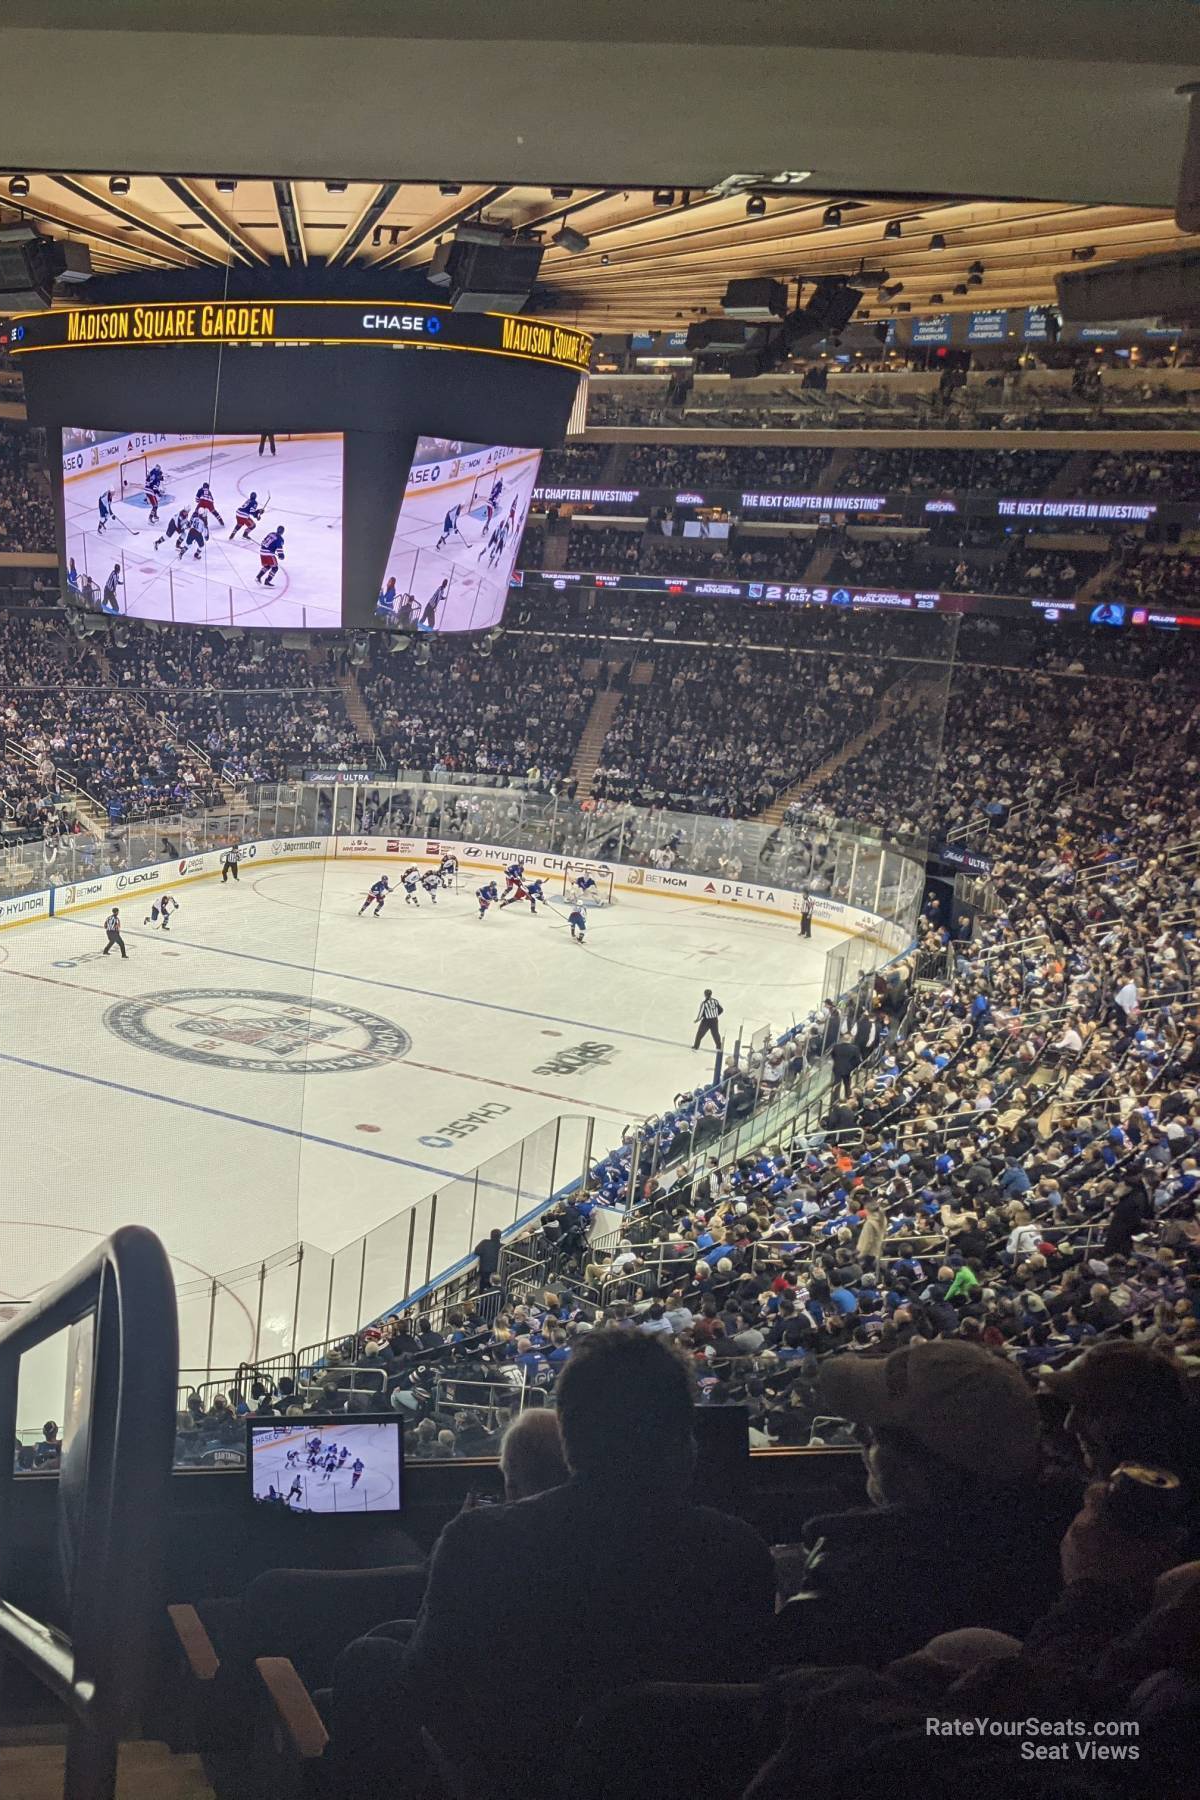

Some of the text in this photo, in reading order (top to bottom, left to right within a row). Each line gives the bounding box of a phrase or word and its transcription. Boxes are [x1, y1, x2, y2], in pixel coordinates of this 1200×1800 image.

[68, 306, 274, 341] MADISON SQUARE GARDEN
[363, 315, 423, 331] CHASE
[502, 318, 551, 356] MADISON
[545, 489, 581, 500] CHAPTER
[582, 490, 591, 500] IN
[742, 494, 758, 506] THE
[759, 495, 782, 507] NEXT
[783, 496, 822, 509] CHAPTER
[823, 497, 833, 509] IN
[998, 502, 1016, 514] THE
[1017, 503, 1042, 516] NEXT
[1043, 503, 1085, 517] CHAPTER
[1086, 505, 1098, 517] IN
[695, 586, 741, 595] RANGERS
[766, 587, 782, 599] 2
[785, 593, 811, 602] 10:57
[812, 589, 828, 602] 3
[853, 595, 911, 605] AVALANCHE
[917, 601, 934, 609] 23
[1031, 601, 1076, 610] TAKEAWAYS
[1044, 609, 1059, 620] 3
[1148, 615, 1178, 623] FOLLOW
[343, 773, 370, 781] ULTRA
[220, 847, 249, 865] CSE
[485, 849, 537, 865] HYUNDAI
[128, 871, 159, 886] LEXUS
[646, 873, 688, 888] BETMGM
[77, 884, 103, 897] BETMGM
[722, 882, 776, 903] DELTA
[6, 898, 44, 914] HYUNDAI
[227, 1055, 375, 1073] RANGERS
[436, 1102, 511, 1139] CHASE
